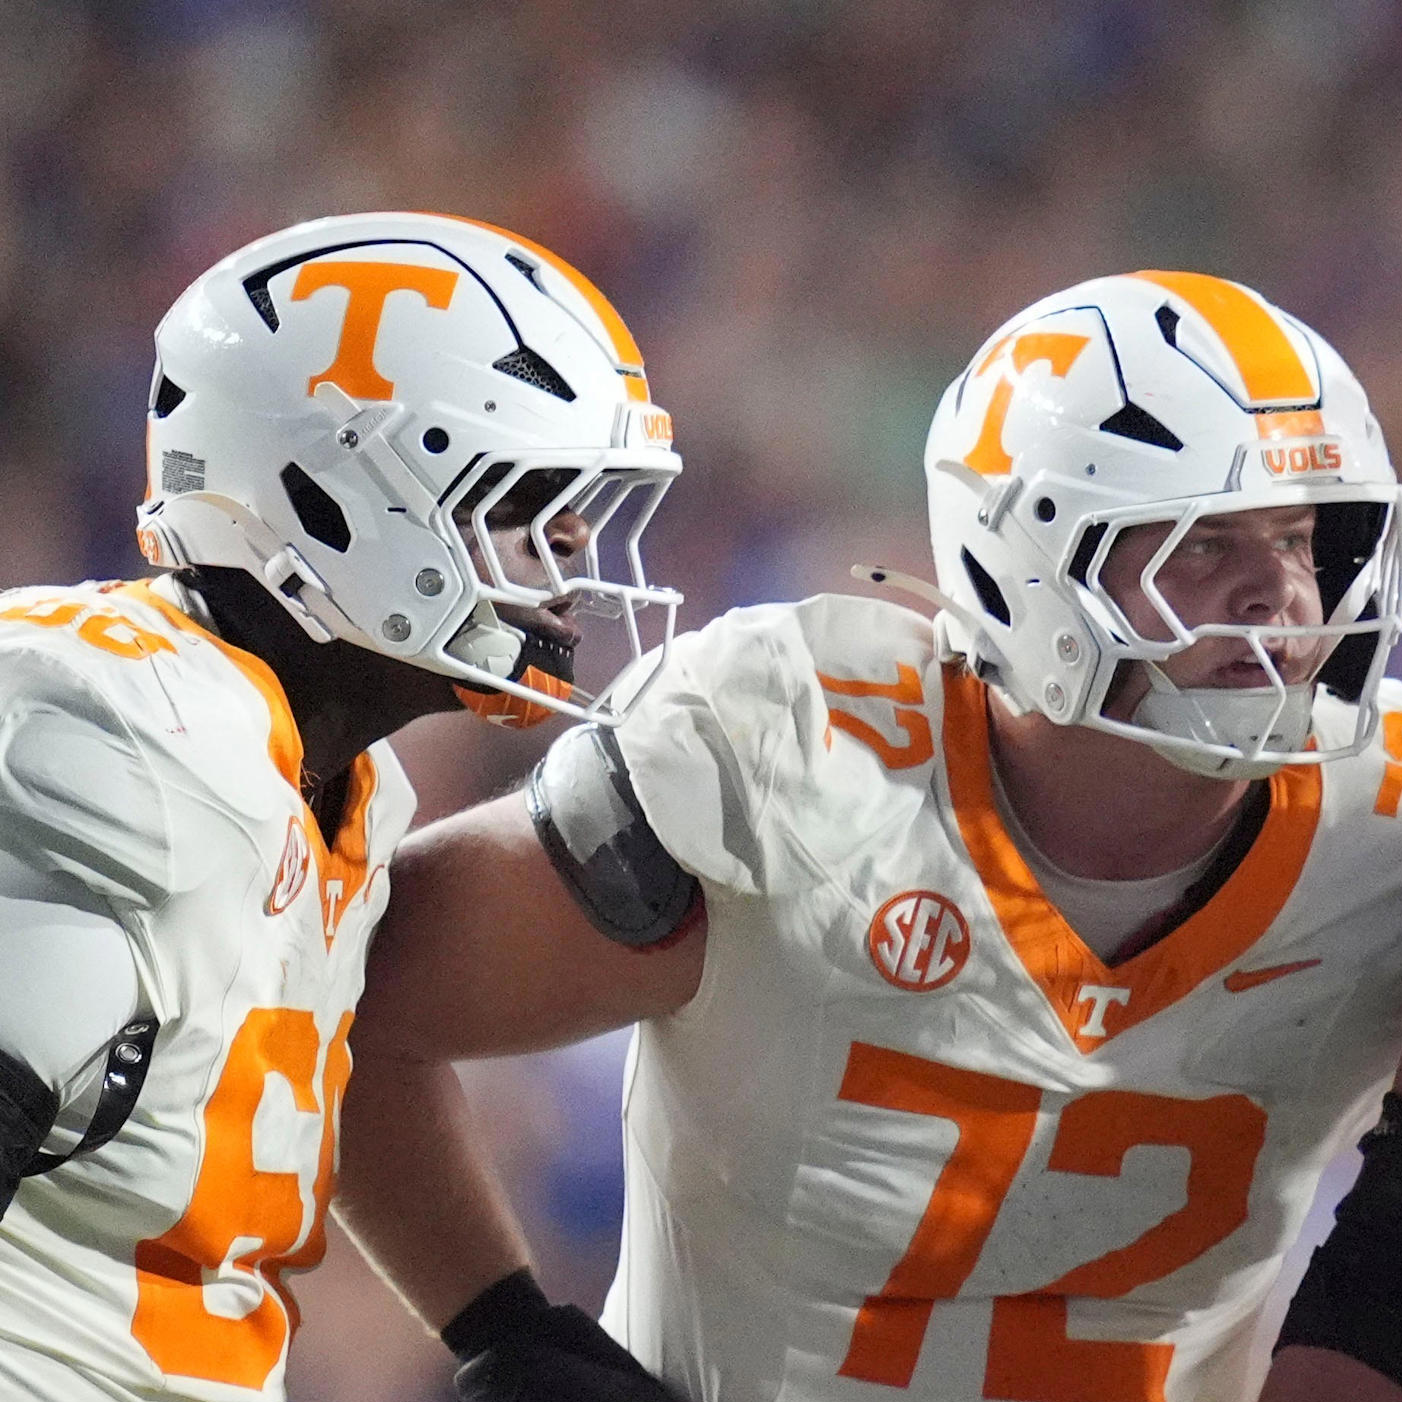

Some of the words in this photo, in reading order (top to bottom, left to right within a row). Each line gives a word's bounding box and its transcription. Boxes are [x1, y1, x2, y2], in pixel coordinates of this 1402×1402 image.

[291, 261, 459, 401] T
[975, 332, 1092, 476] T
[1262, 442, 1342, 474] VOLS
[876, 895, 964, 984] SEC
[1077, 984, 1132, 1037] T
